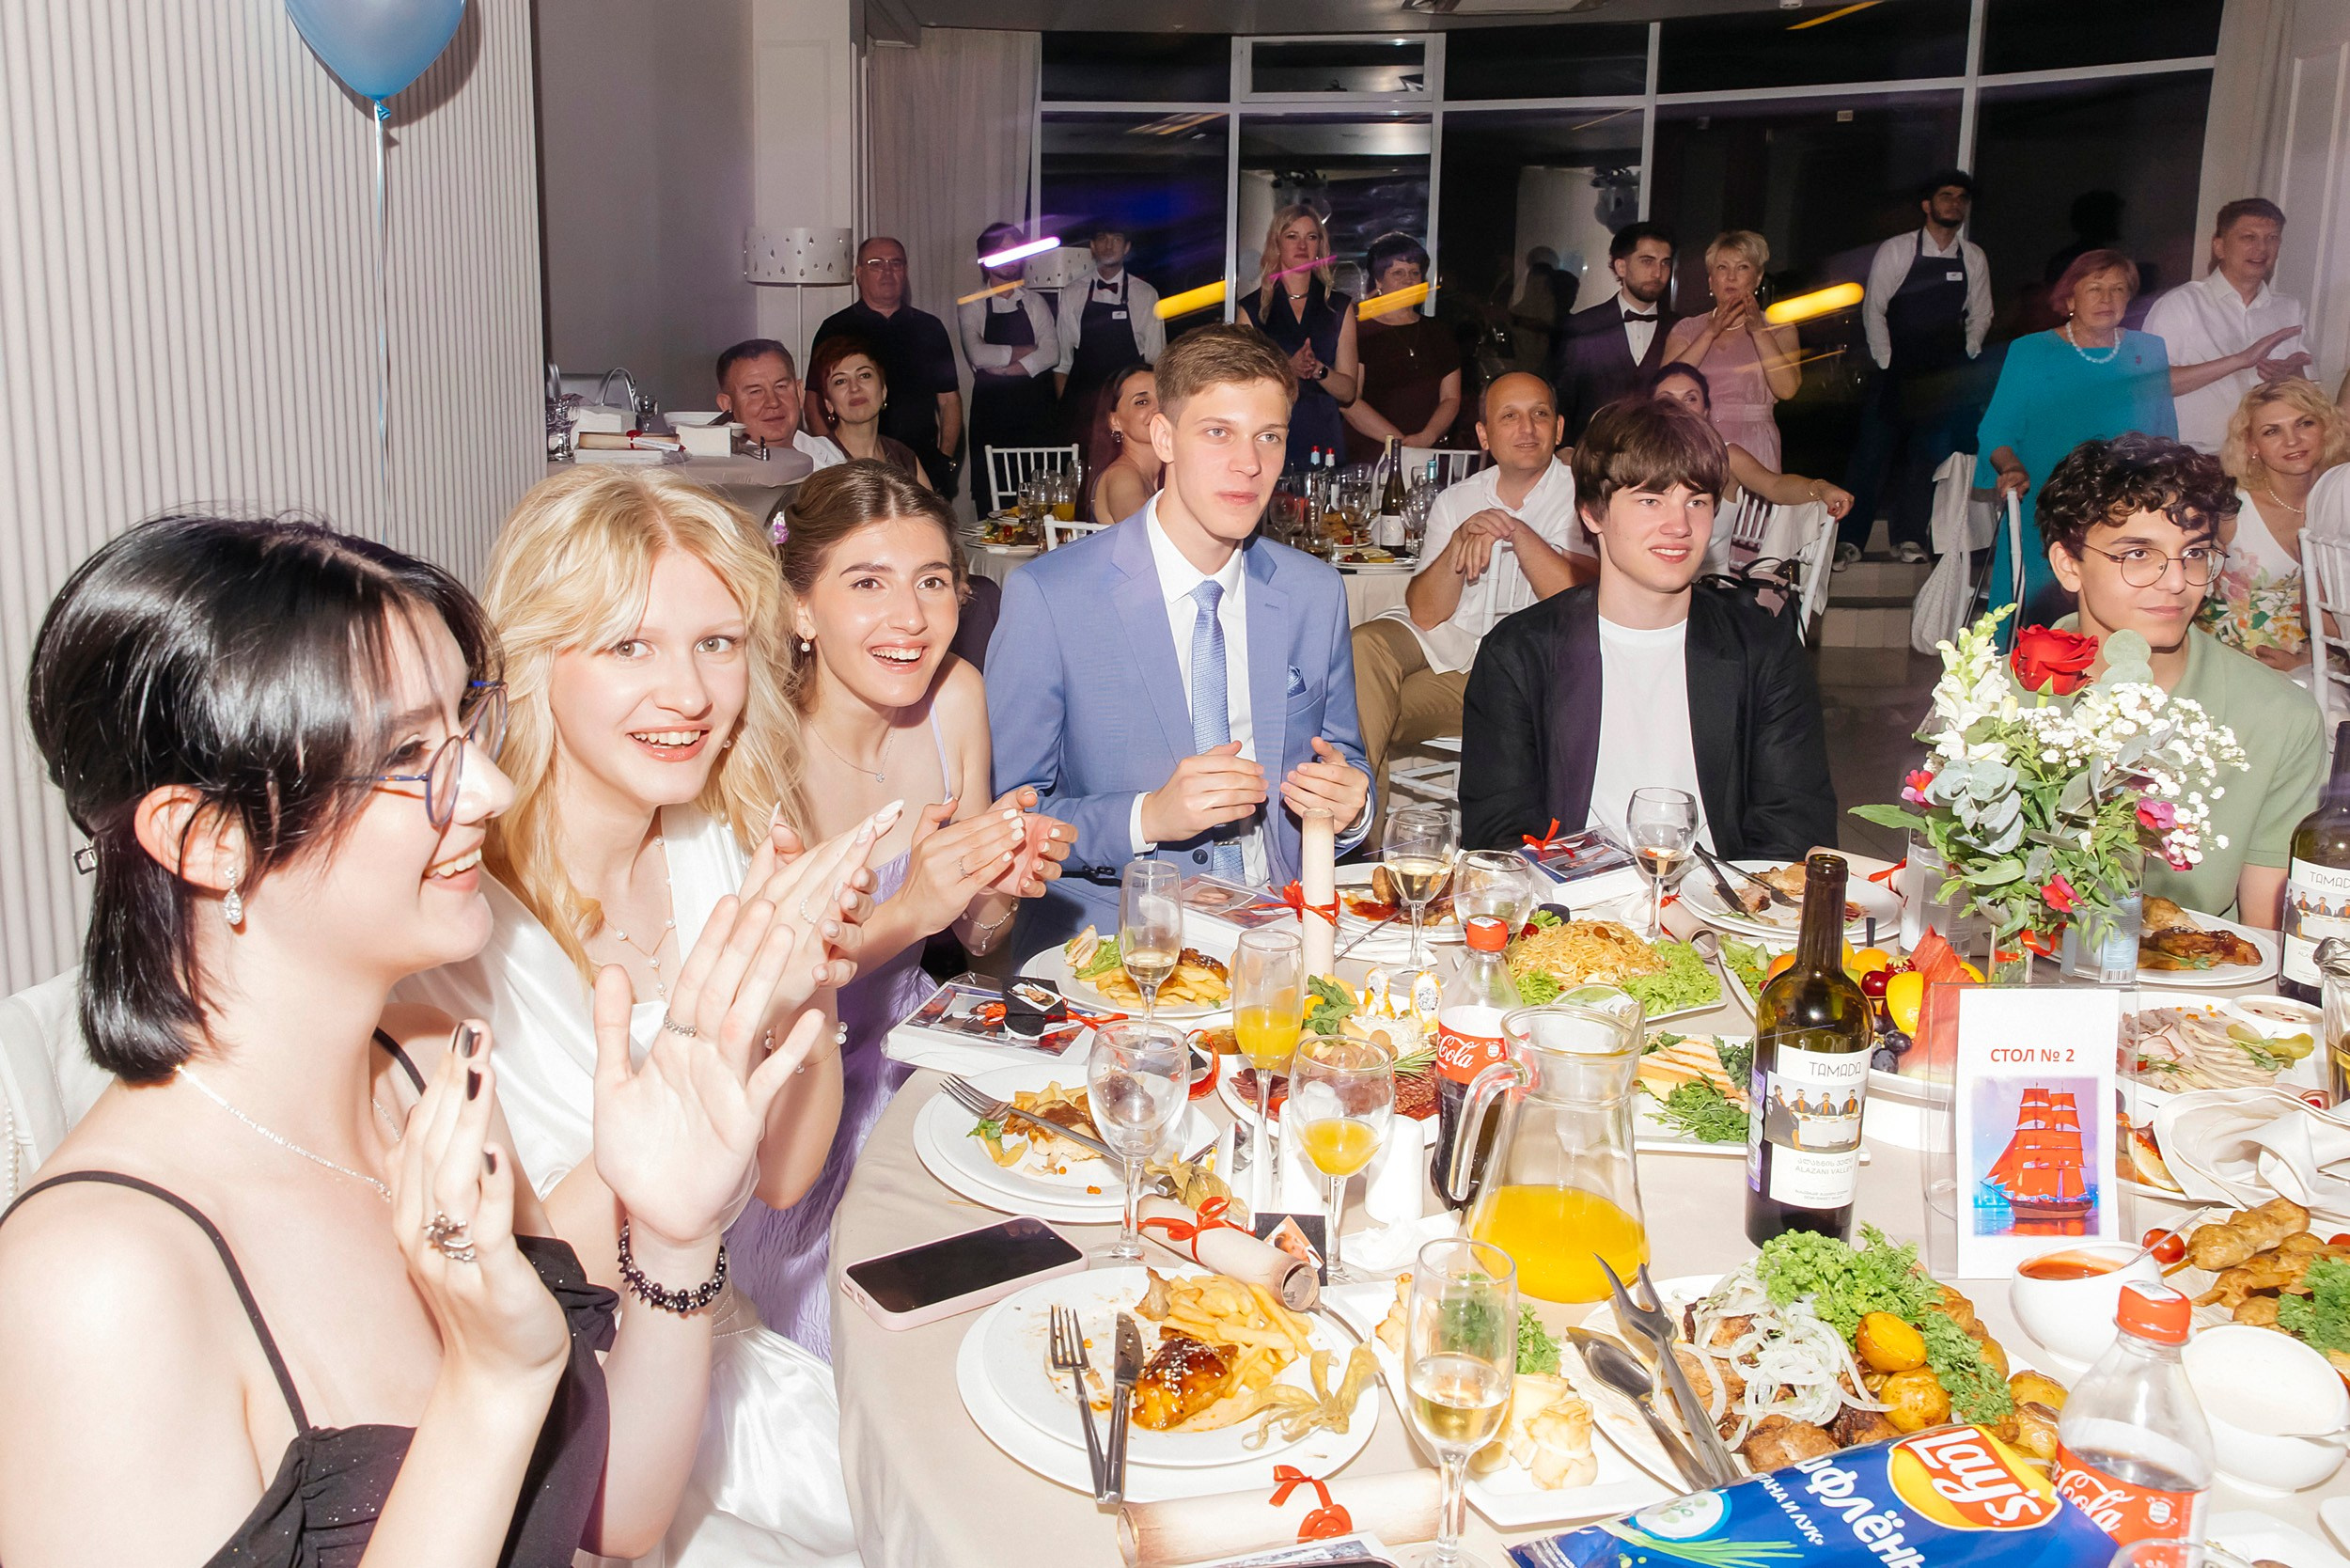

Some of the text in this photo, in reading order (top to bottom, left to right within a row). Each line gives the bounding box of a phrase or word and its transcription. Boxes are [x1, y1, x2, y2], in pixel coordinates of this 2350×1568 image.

[1990, 1048, 2075, 1063] СТОЛ № 2
[1809, 1061, 1861, 1078] TAMADA
[1794, 1165, 1829, 1175] ALAZANI
[1906, 1428, 2042, 1522] Lay's
